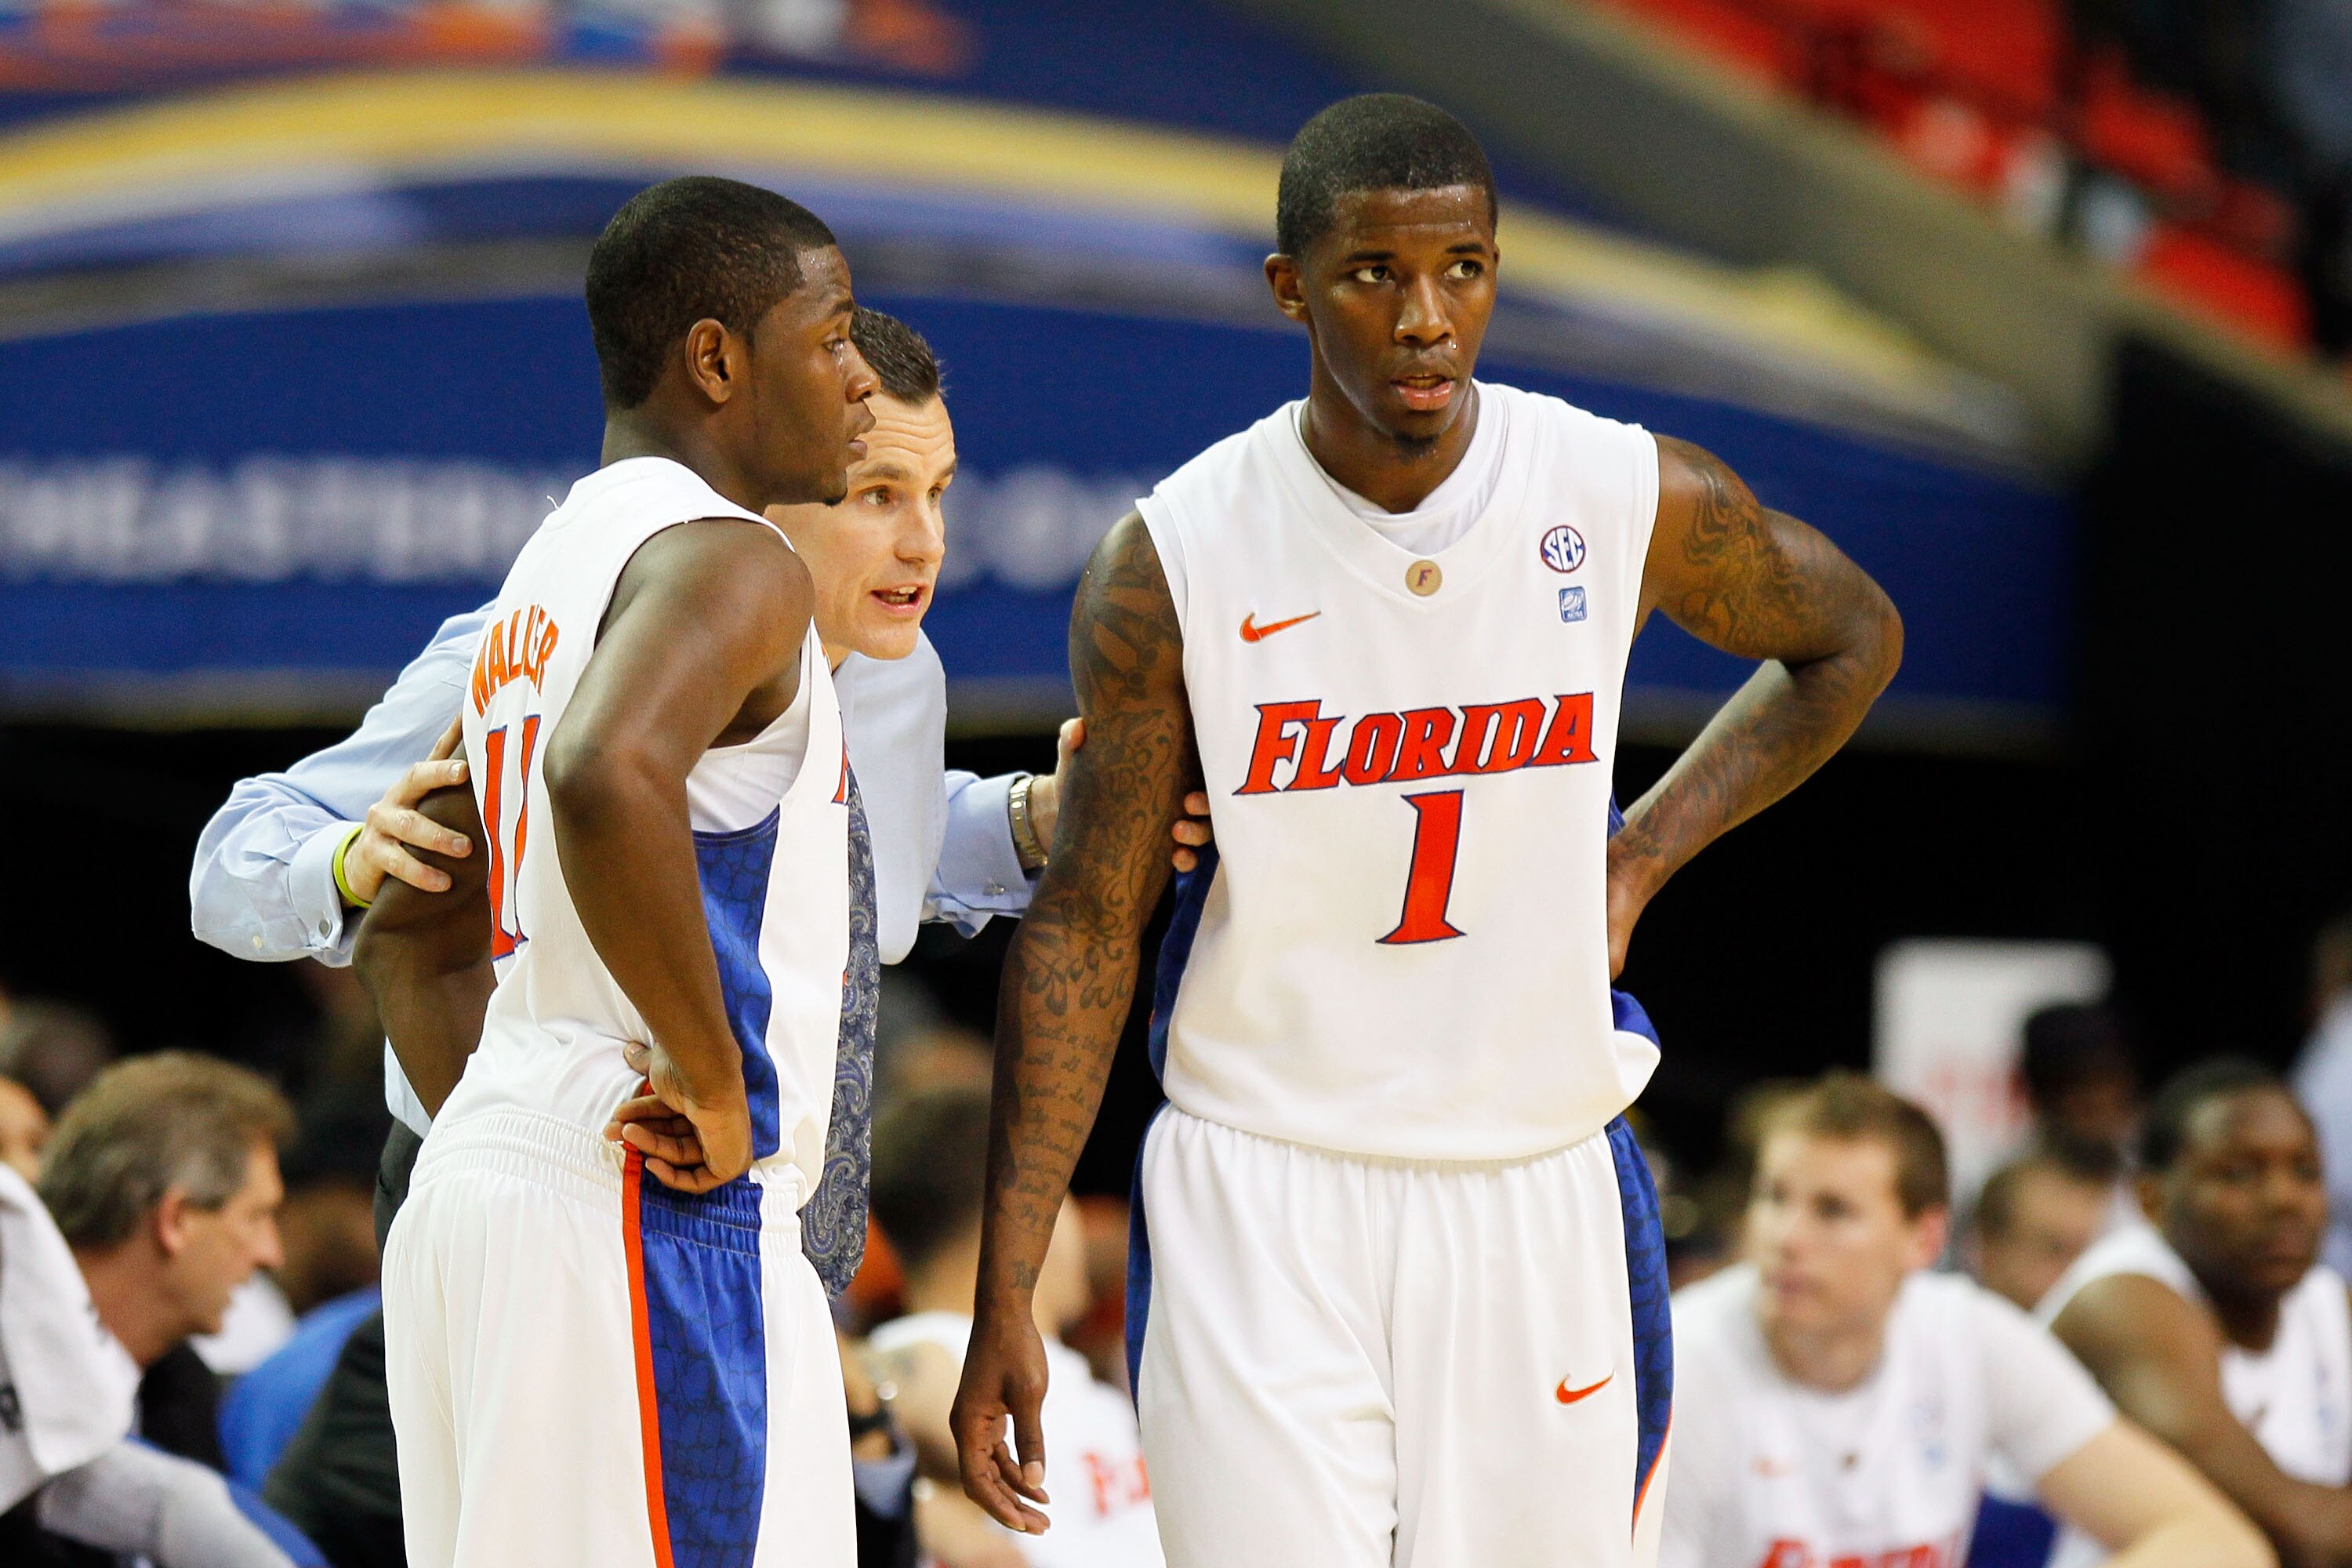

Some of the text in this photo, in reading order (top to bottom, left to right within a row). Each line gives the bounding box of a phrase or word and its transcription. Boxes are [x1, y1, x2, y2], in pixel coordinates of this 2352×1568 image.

[1416, 568, 1432, 587] F
[1541, 525, 1584, 572] SEC
[1232, 691, 1599, 795] FLORIDA
[1375, 789, 1467, 945] 1
